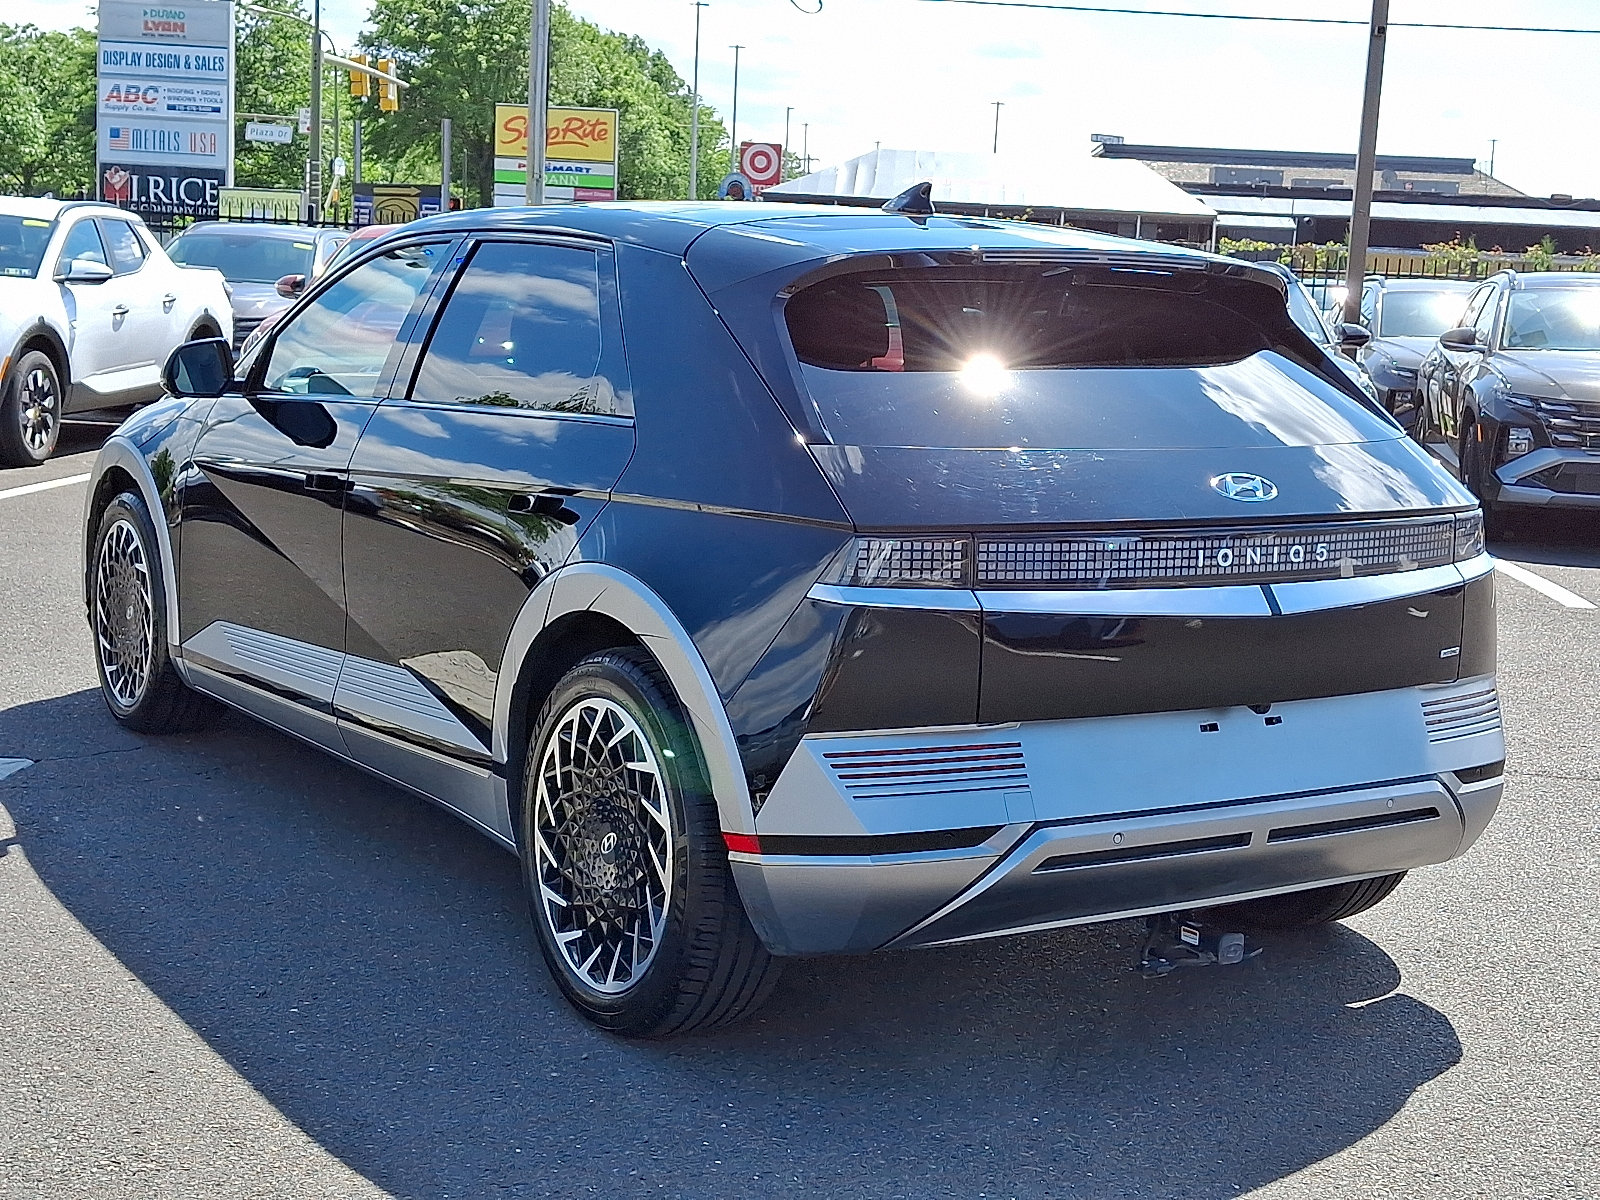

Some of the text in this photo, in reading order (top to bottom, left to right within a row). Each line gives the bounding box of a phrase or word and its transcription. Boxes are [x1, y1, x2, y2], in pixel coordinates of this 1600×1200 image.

[143, 20, 186, 32] LYON
[103, 50, 225, 72] DISPLAY DESIGN & SALES
[103, 83, 159, 104] ABC
[104, 103, 129, 112] Supply
[250, 127, 288, 138] Plaza Dr
[132, 128, 216, 154] METALS USA
